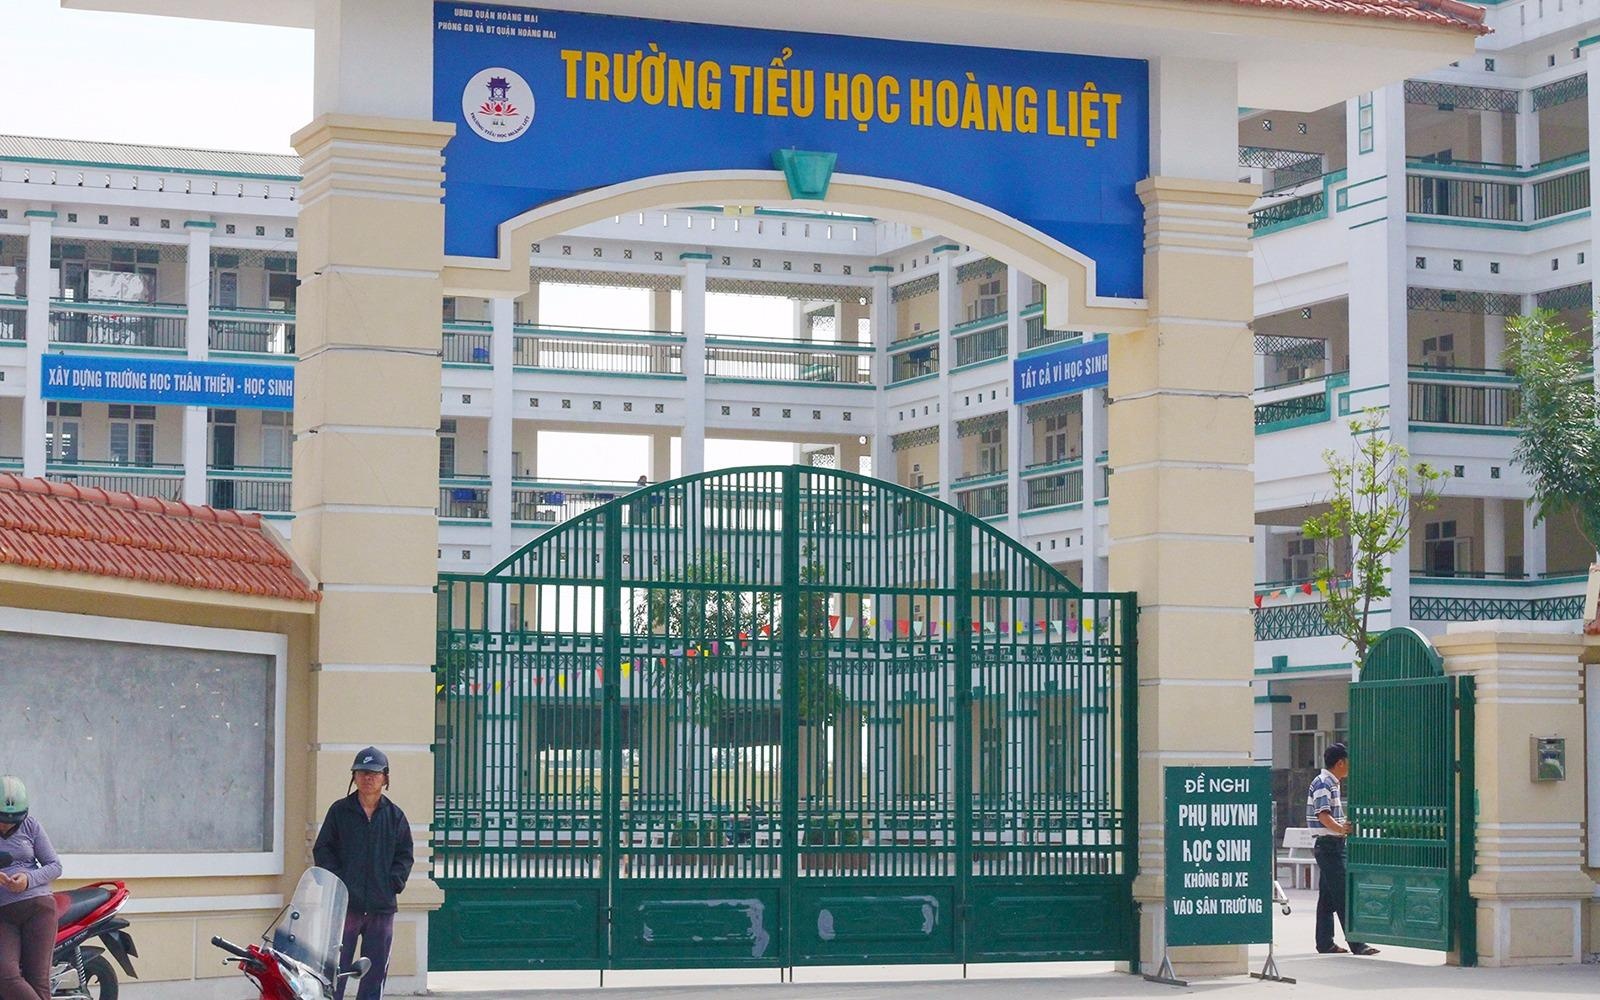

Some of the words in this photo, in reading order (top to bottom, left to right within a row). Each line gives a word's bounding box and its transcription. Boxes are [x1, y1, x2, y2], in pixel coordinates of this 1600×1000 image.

[454, 8, 473, 17] UBND
[524, 14, 538, 23] MAI
[543, 30, 556, 39] MAI
[561, 43, 721, 110] TRƯỜNG
[730, 47, 814, 117] TIỂU
[825, 72, 900, 132] HỌC
[910, 72, 1038, 134] HOÀNG
[1047, 82, 1122, 147] LIỆT
[49, 365, 69, 386] XÂY
[72, 370, 101, 391] DỰNG
[105, 368, 146, 390] TRƯỜNG
[150, 374, 171, 393] HỌC
[174, 371, 201, 393] THÂN
[204, 374, 234, 397] THIỆN
[244, 378, 265, 398] HỌC
[268, 379, 293, 397] SINH
[1021, 365, 1036, 389] TẤT
[1039, 362, 1050, 386] CẢ
[1053, 361, 1062, 382] VÌ
[1064, 359, 1083, 382] HỌC
[1085, 354, 1108, 375] SINH
[1184, 772, 1205, 793] ĐỀ
[1209, 778, 1250, 793] NGHI
[1179, 804, 1207, 832] PHỤ
[1211, 804, 1258, 826] HUYNH
[1216, 839, 1251, 862] SINH
[1184, 869, 1219, 888] KHÔNG
[1222, 872, 1233, 887] ĐI
[1235, 872, 1249, 887] XE
[1173, 896, 1194, 915] VÀO
[1196, 895, 1218, 915] SÂN
[1220, 894, 1263, 914] TRƯỜNG
